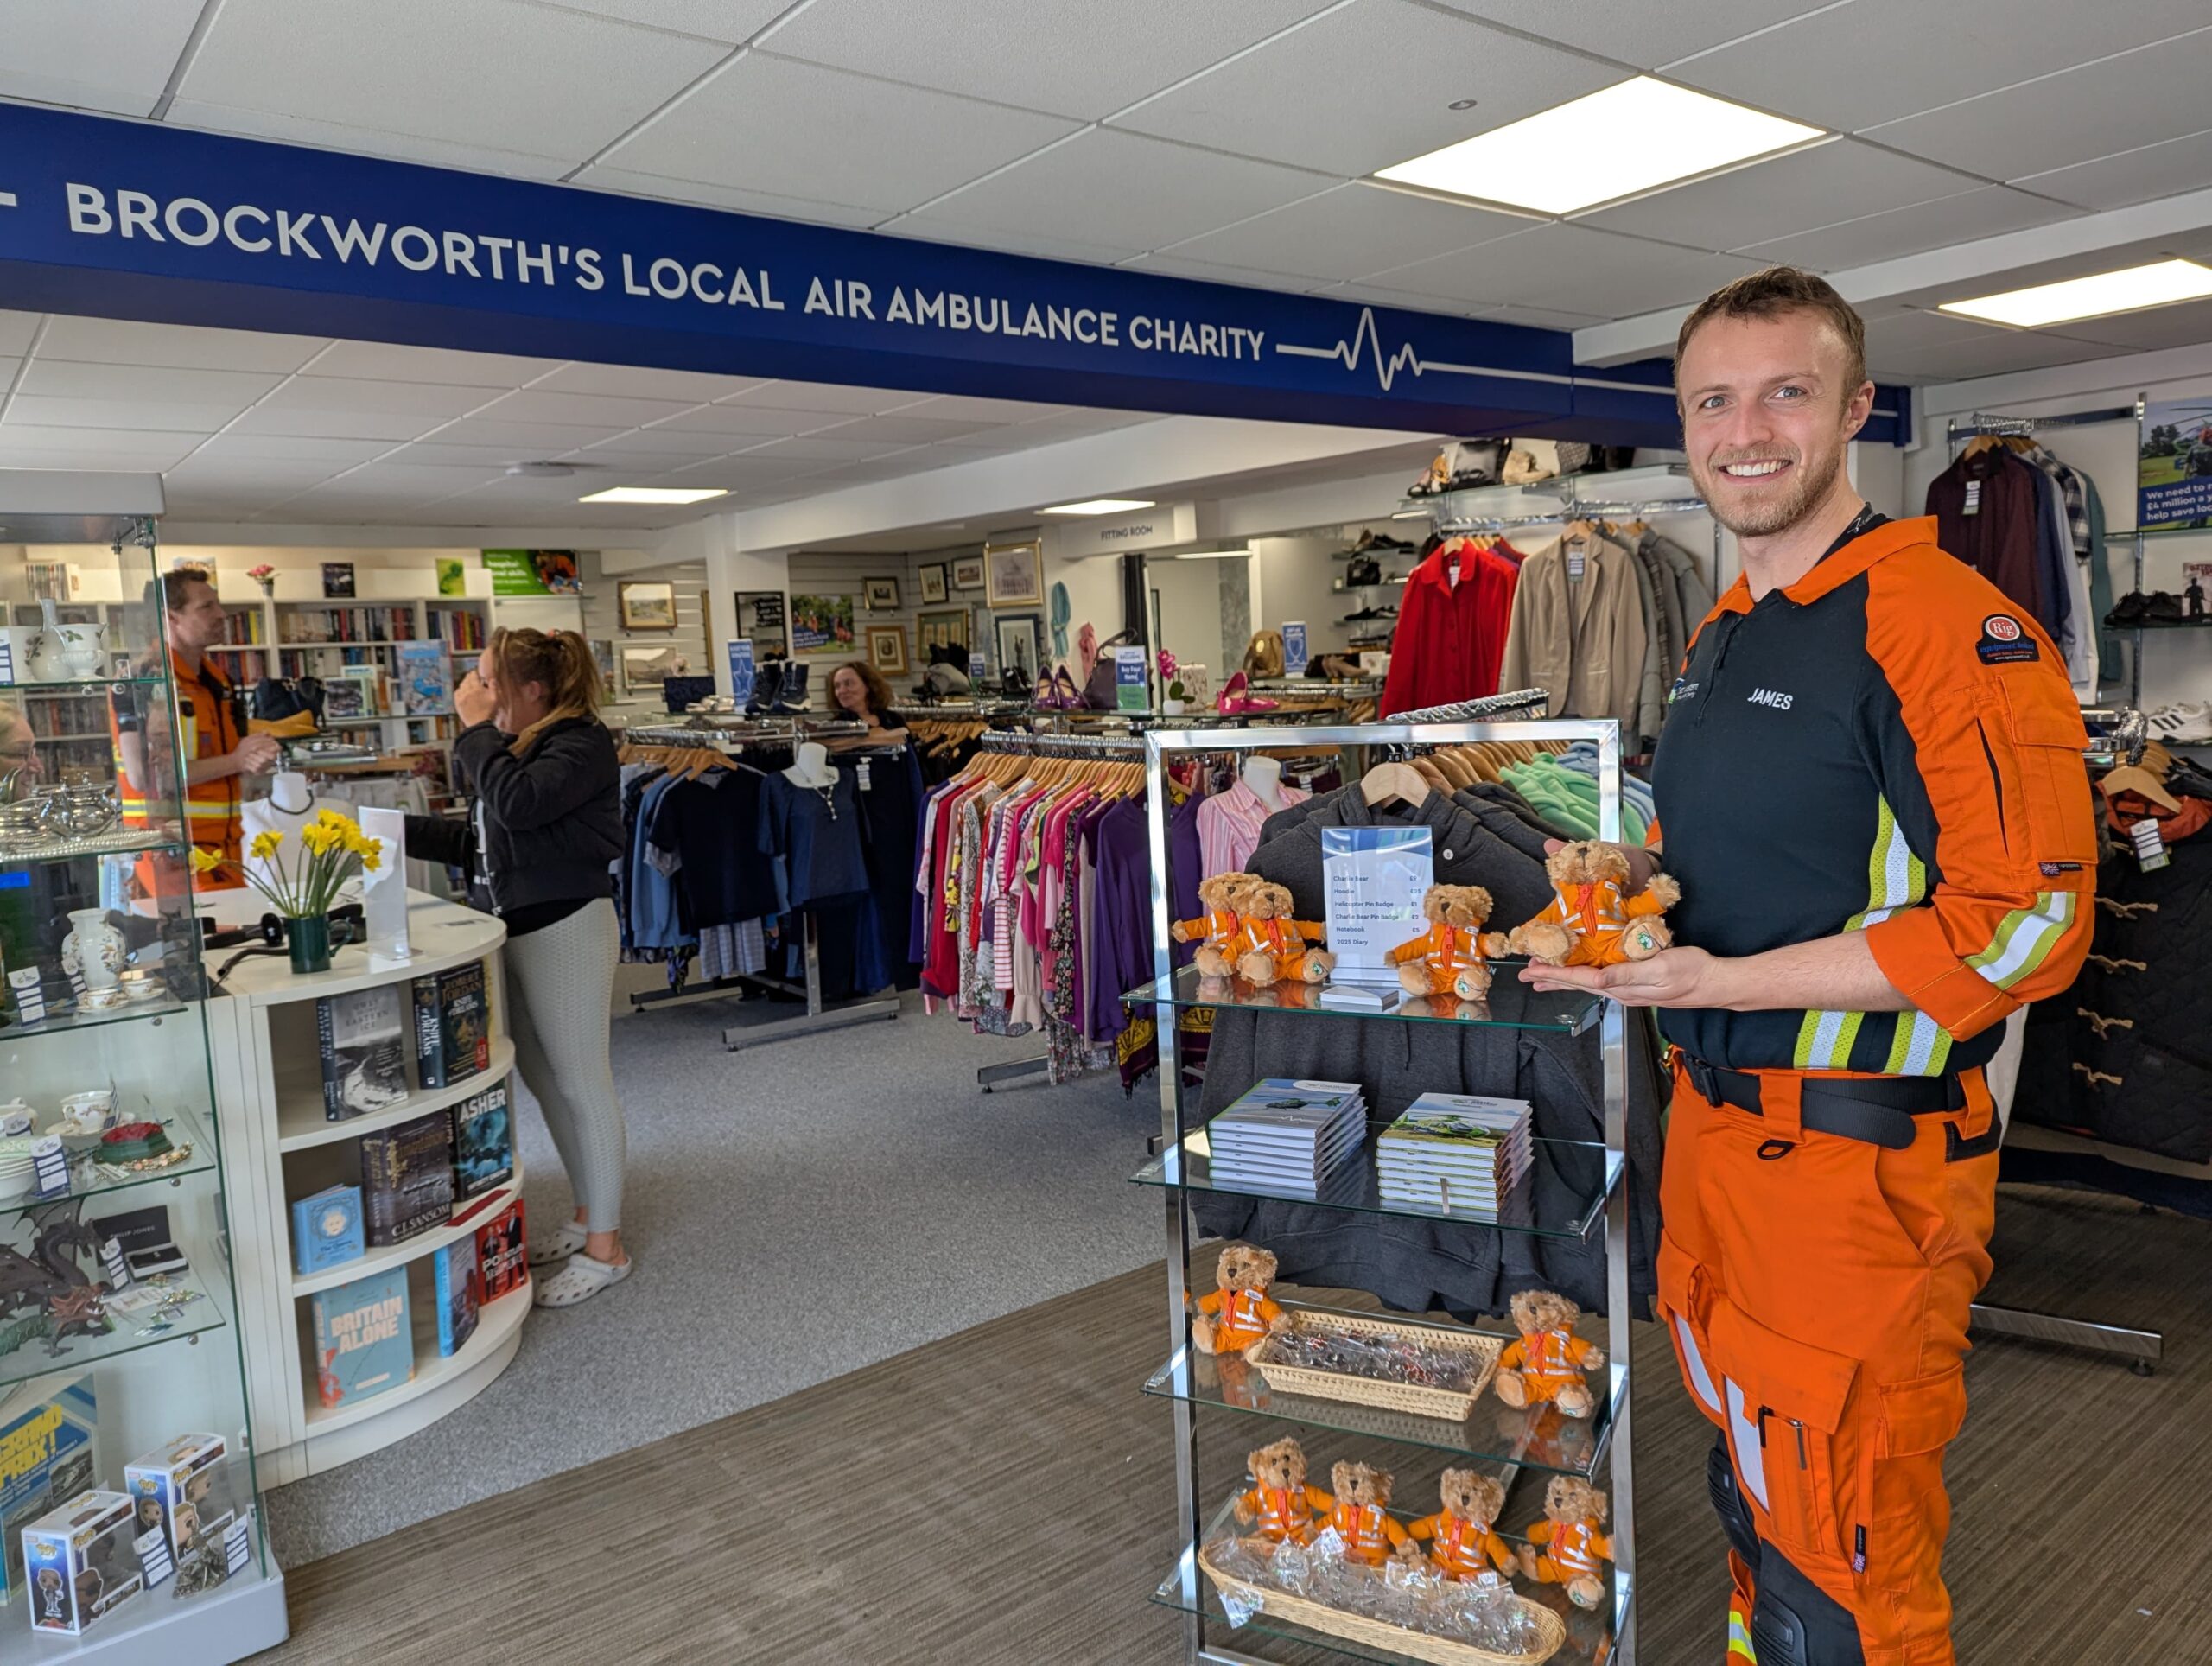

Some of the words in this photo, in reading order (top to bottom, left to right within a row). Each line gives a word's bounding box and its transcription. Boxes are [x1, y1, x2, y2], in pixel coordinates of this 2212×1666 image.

[65, 181, 605, 292] BROCKWORTH'S
[622, 253, 785, 311] LOCAL
[804, 277, 876, 321] AIR
[886, 286, 1120, 347] AMBULANCE
[1128, 315, 1265, 362] CHARITY
[2165, 485, 2191, 497] need
[2147, 511, 2169, 520] help
[2172, 507, 2195, 517] save
[2162, 497, 2196, 508] million
[1101, 527, 1128, 540] FITTING
[1130, 525, 1153, 536] ROOM
[1993, 622, 2014, 636] Rig
[1747, 688, 1793, 710] JAMES
[421, 1015, 432, 1056] DREAMS
[429, 1018, 441, 1046] KNIFE
[459, 1089, 506, 1123] ASHER
[133, 1225, 156, 1236] JONES
[331, 1295, 404, 1337] BRITAIN
[339, 1316, 399, 1355] ALONE
